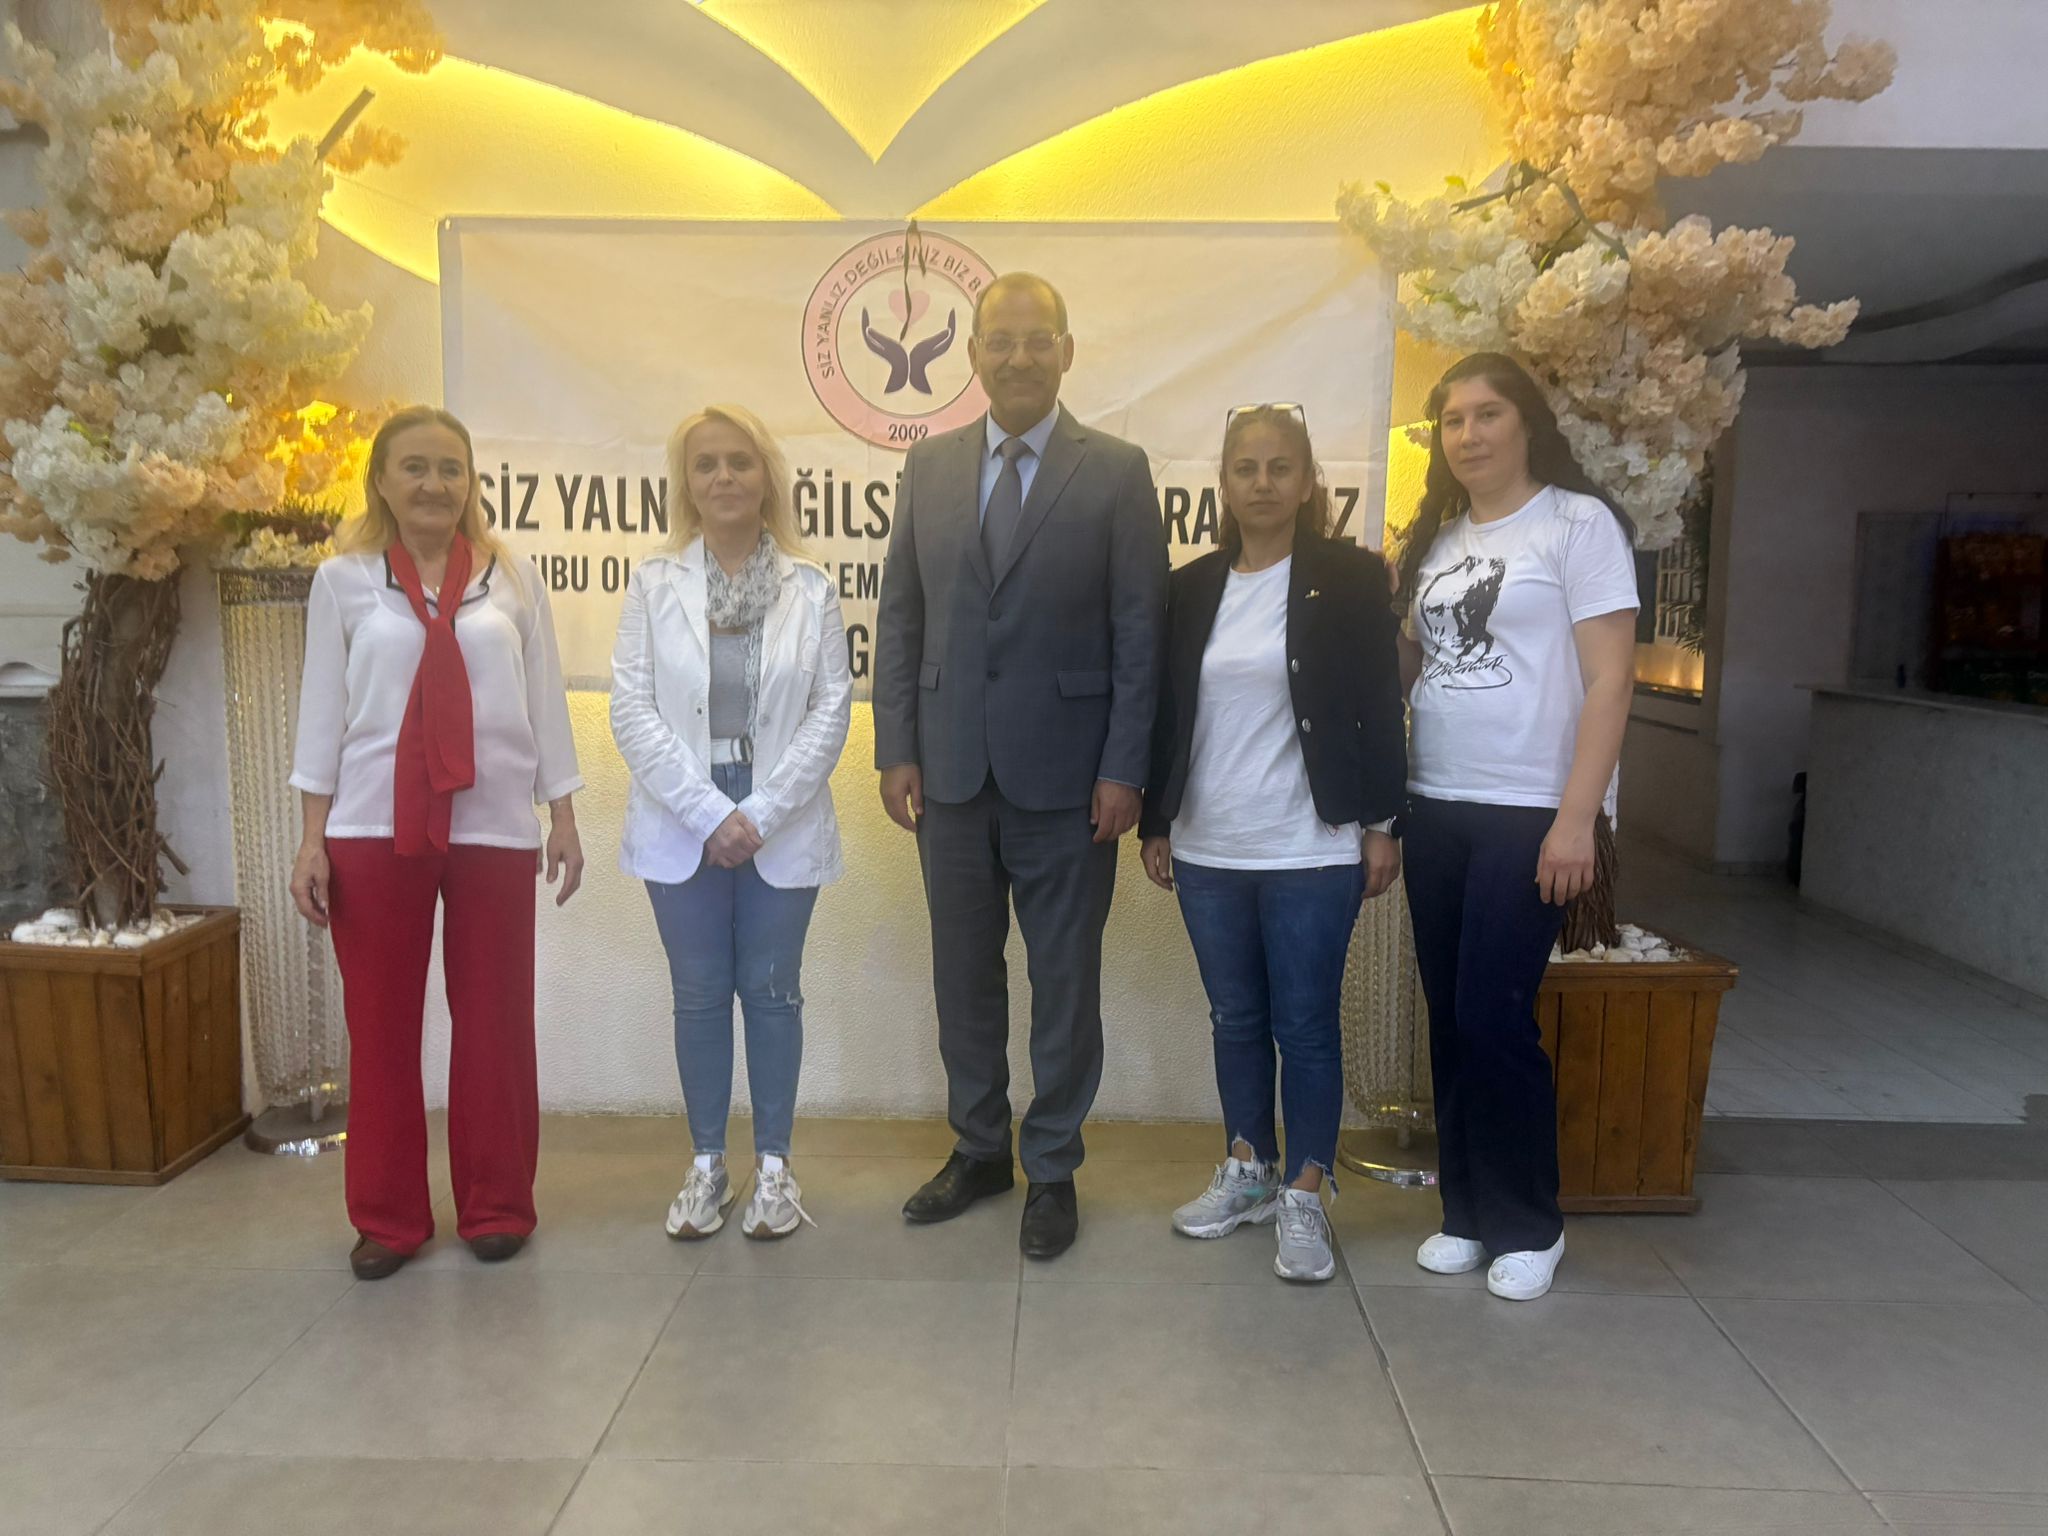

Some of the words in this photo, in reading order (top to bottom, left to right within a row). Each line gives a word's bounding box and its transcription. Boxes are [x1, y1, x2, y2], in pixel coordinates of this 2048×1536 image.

[816, 349, 835, 380] SİZ
[888, 423, 928, 442] 2009
[478, 462, 540, 532] SİZ
[554, 473, 669, 534] YALN
